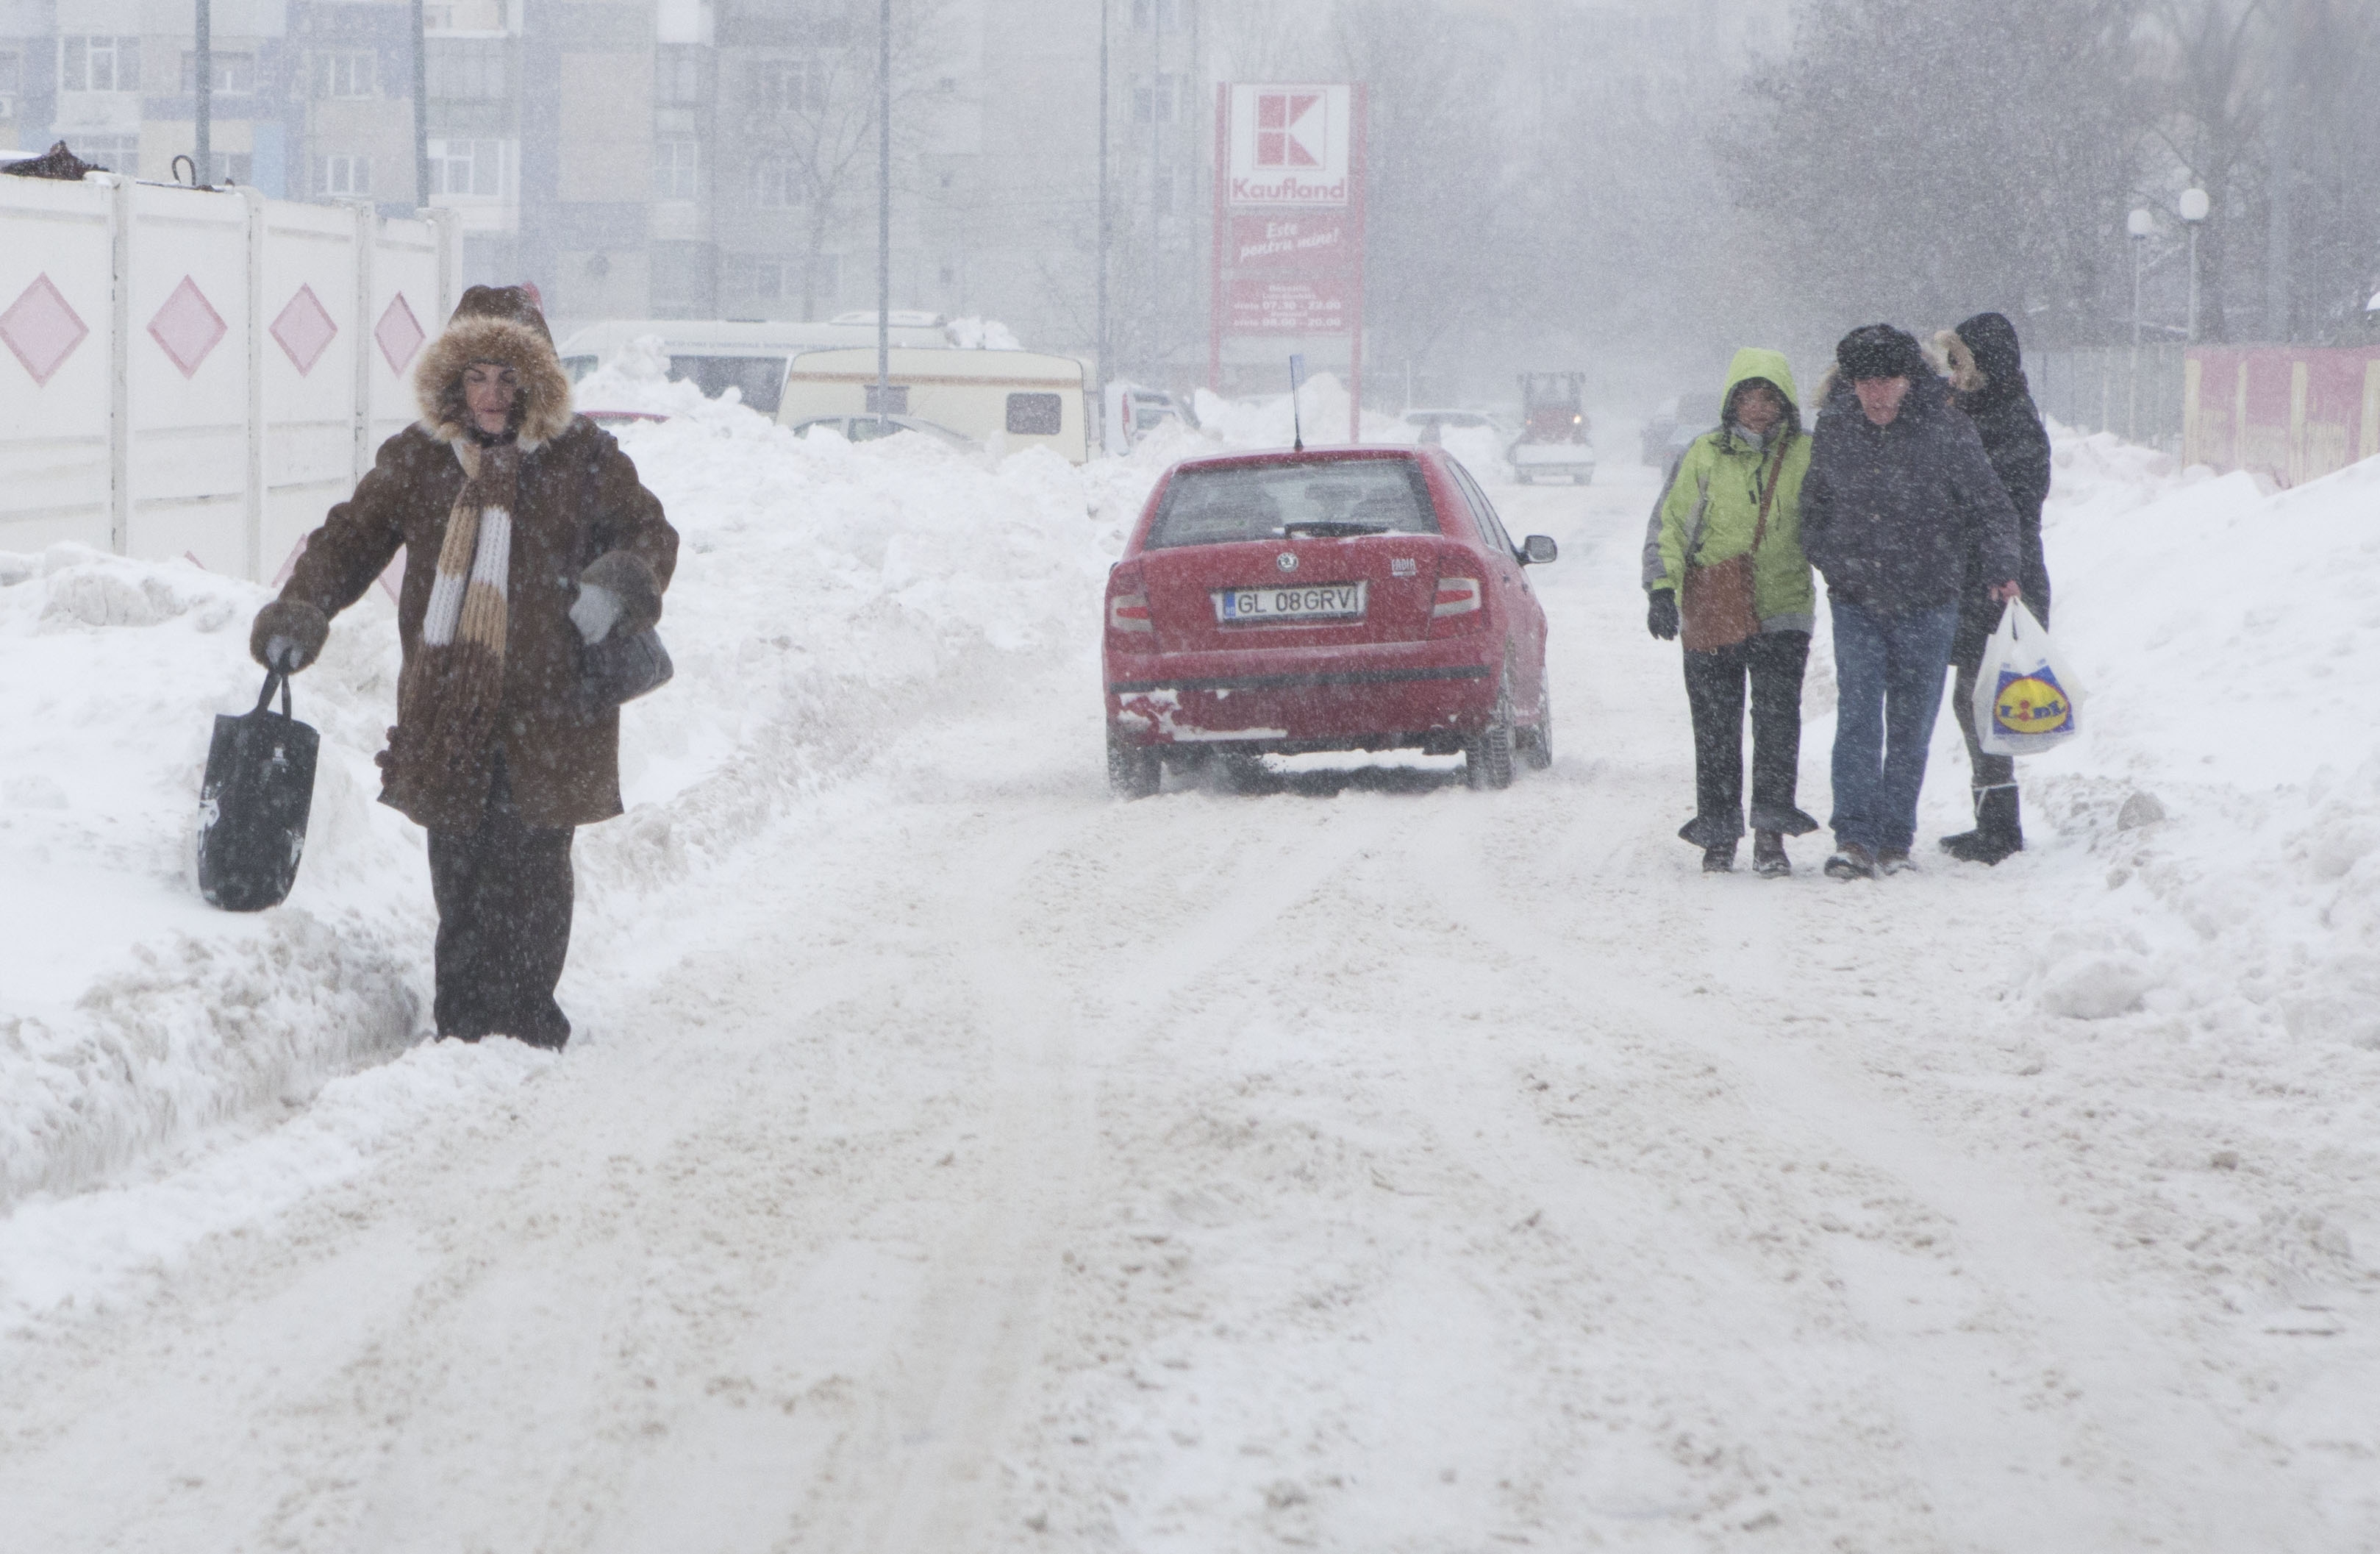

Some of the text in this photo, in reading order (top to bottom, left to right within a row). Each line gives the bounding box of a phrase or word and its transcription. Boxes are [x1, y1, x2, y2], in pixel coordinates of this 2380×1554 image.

[1232, 177, 1345, 199] Kaufland
[1266, 222, 1298, 238] Este
[1240, 227, 1340, 263] pentru mine!
[1238, 594, 1266, 613] GL
